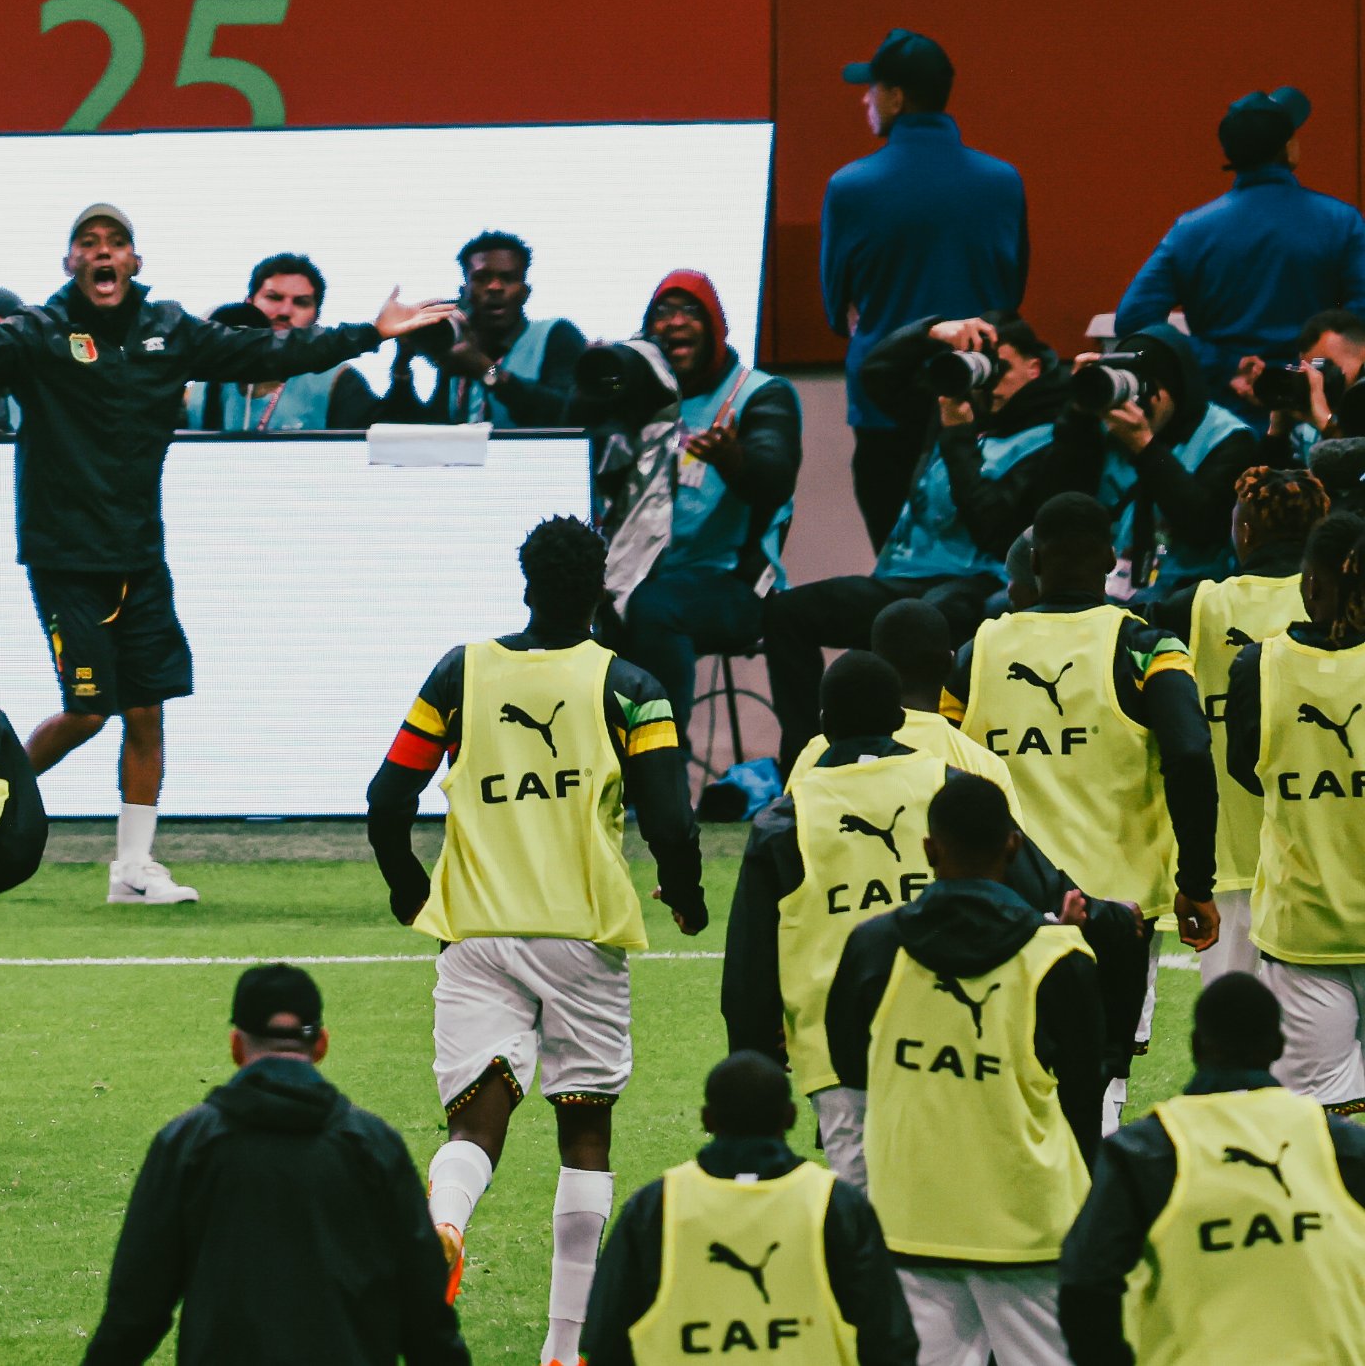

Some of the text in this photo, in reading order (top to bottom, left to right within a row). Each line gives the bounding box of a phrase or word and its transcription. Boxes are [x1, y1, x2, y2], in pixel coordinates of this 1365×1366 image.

[986, 727, 1087, 757] CAF
[480, 769, 580, 804] CAF
[1278, 770, 1365, 801] CAF
[828, 873, 929, 915] CAF
[896, 1038, 1001, 1082] CAF
[1199, 1212, 1323, 1253] CAF
[681, 1318, 800, 1354] CAF
